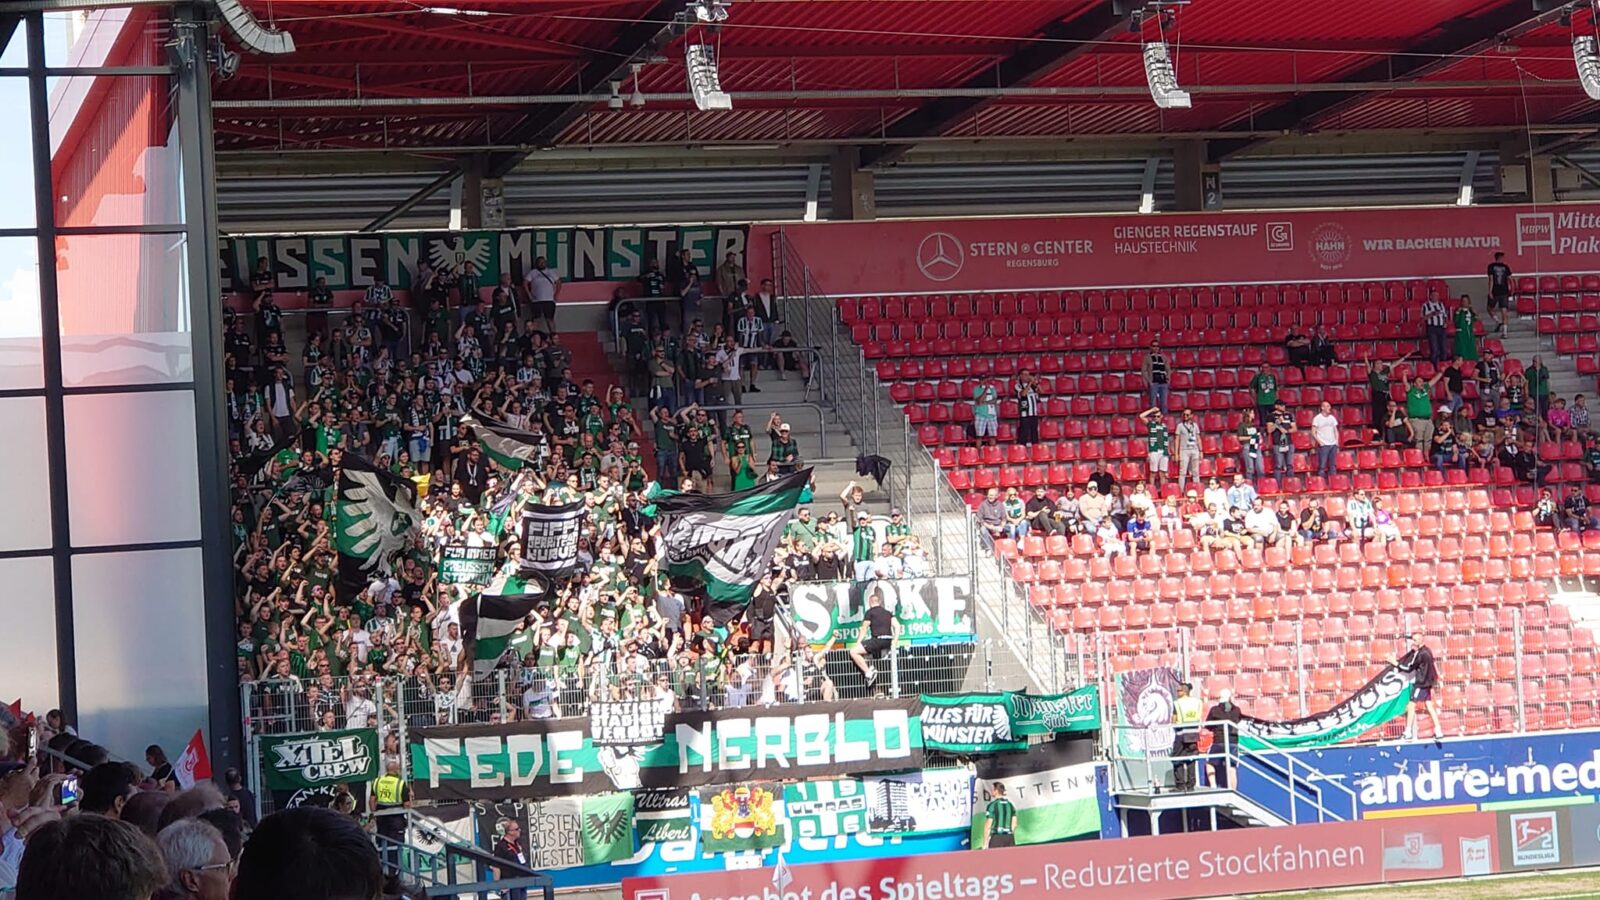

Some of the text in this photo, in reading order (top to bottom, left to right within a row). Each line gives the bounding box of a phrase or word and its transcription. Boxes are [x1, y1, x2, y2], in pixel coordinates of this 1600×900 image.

[1207, 192, 1216, 204] 2
[1114, 223, 1258, 240] GIENGER REGENSTAUF
[1521, 224, 1550, 235] MBPW
[970, 239, 1093, 257] STERN CENTER
[1114, 240, 1198, 255] HAUSTECHNIK
[1315, 240, 1345, 251] HAHN
[1363, 235, 1501, 251] WIR BACKEN NATUR
[1559, 235, 1600, 255] Plak
[500, 229, 745, 279] MÜNSTER
[1006, 258, 1060, 268] REGENSBURG
[443, 560, 495, 574] PREUSSEN
[792, 577, 972, 644] SLOKE
[908, 622, 933, 636] 1906
[591, 712, 665, 726] STADION
[920, 703, 993, 724] ALLES FÜR
[591, 724, 665, 739] VERBOT
[424, 709, 911, 788] FEDE NERBLO
[303, 756, 370, 779] CREW
[636, 791, 689, 809] Ultras
[791, 798, 864, 815] ULTRAS
[528, 803, 546, 816] DIE
[529, 814, 582, 833] BESTEN
[531, 830, 583, 849] AUS DEM
[1541, 833, 1553, 848] 2
[531, 847, 584, 868] WESTEN
[821, 881, 871, 900] des
[879, 871, 1014, 900] Spieltags
[1044, 857, 1190, 890] Reduzierte
[1200, 844, 1365, 879] Stockfahnen
